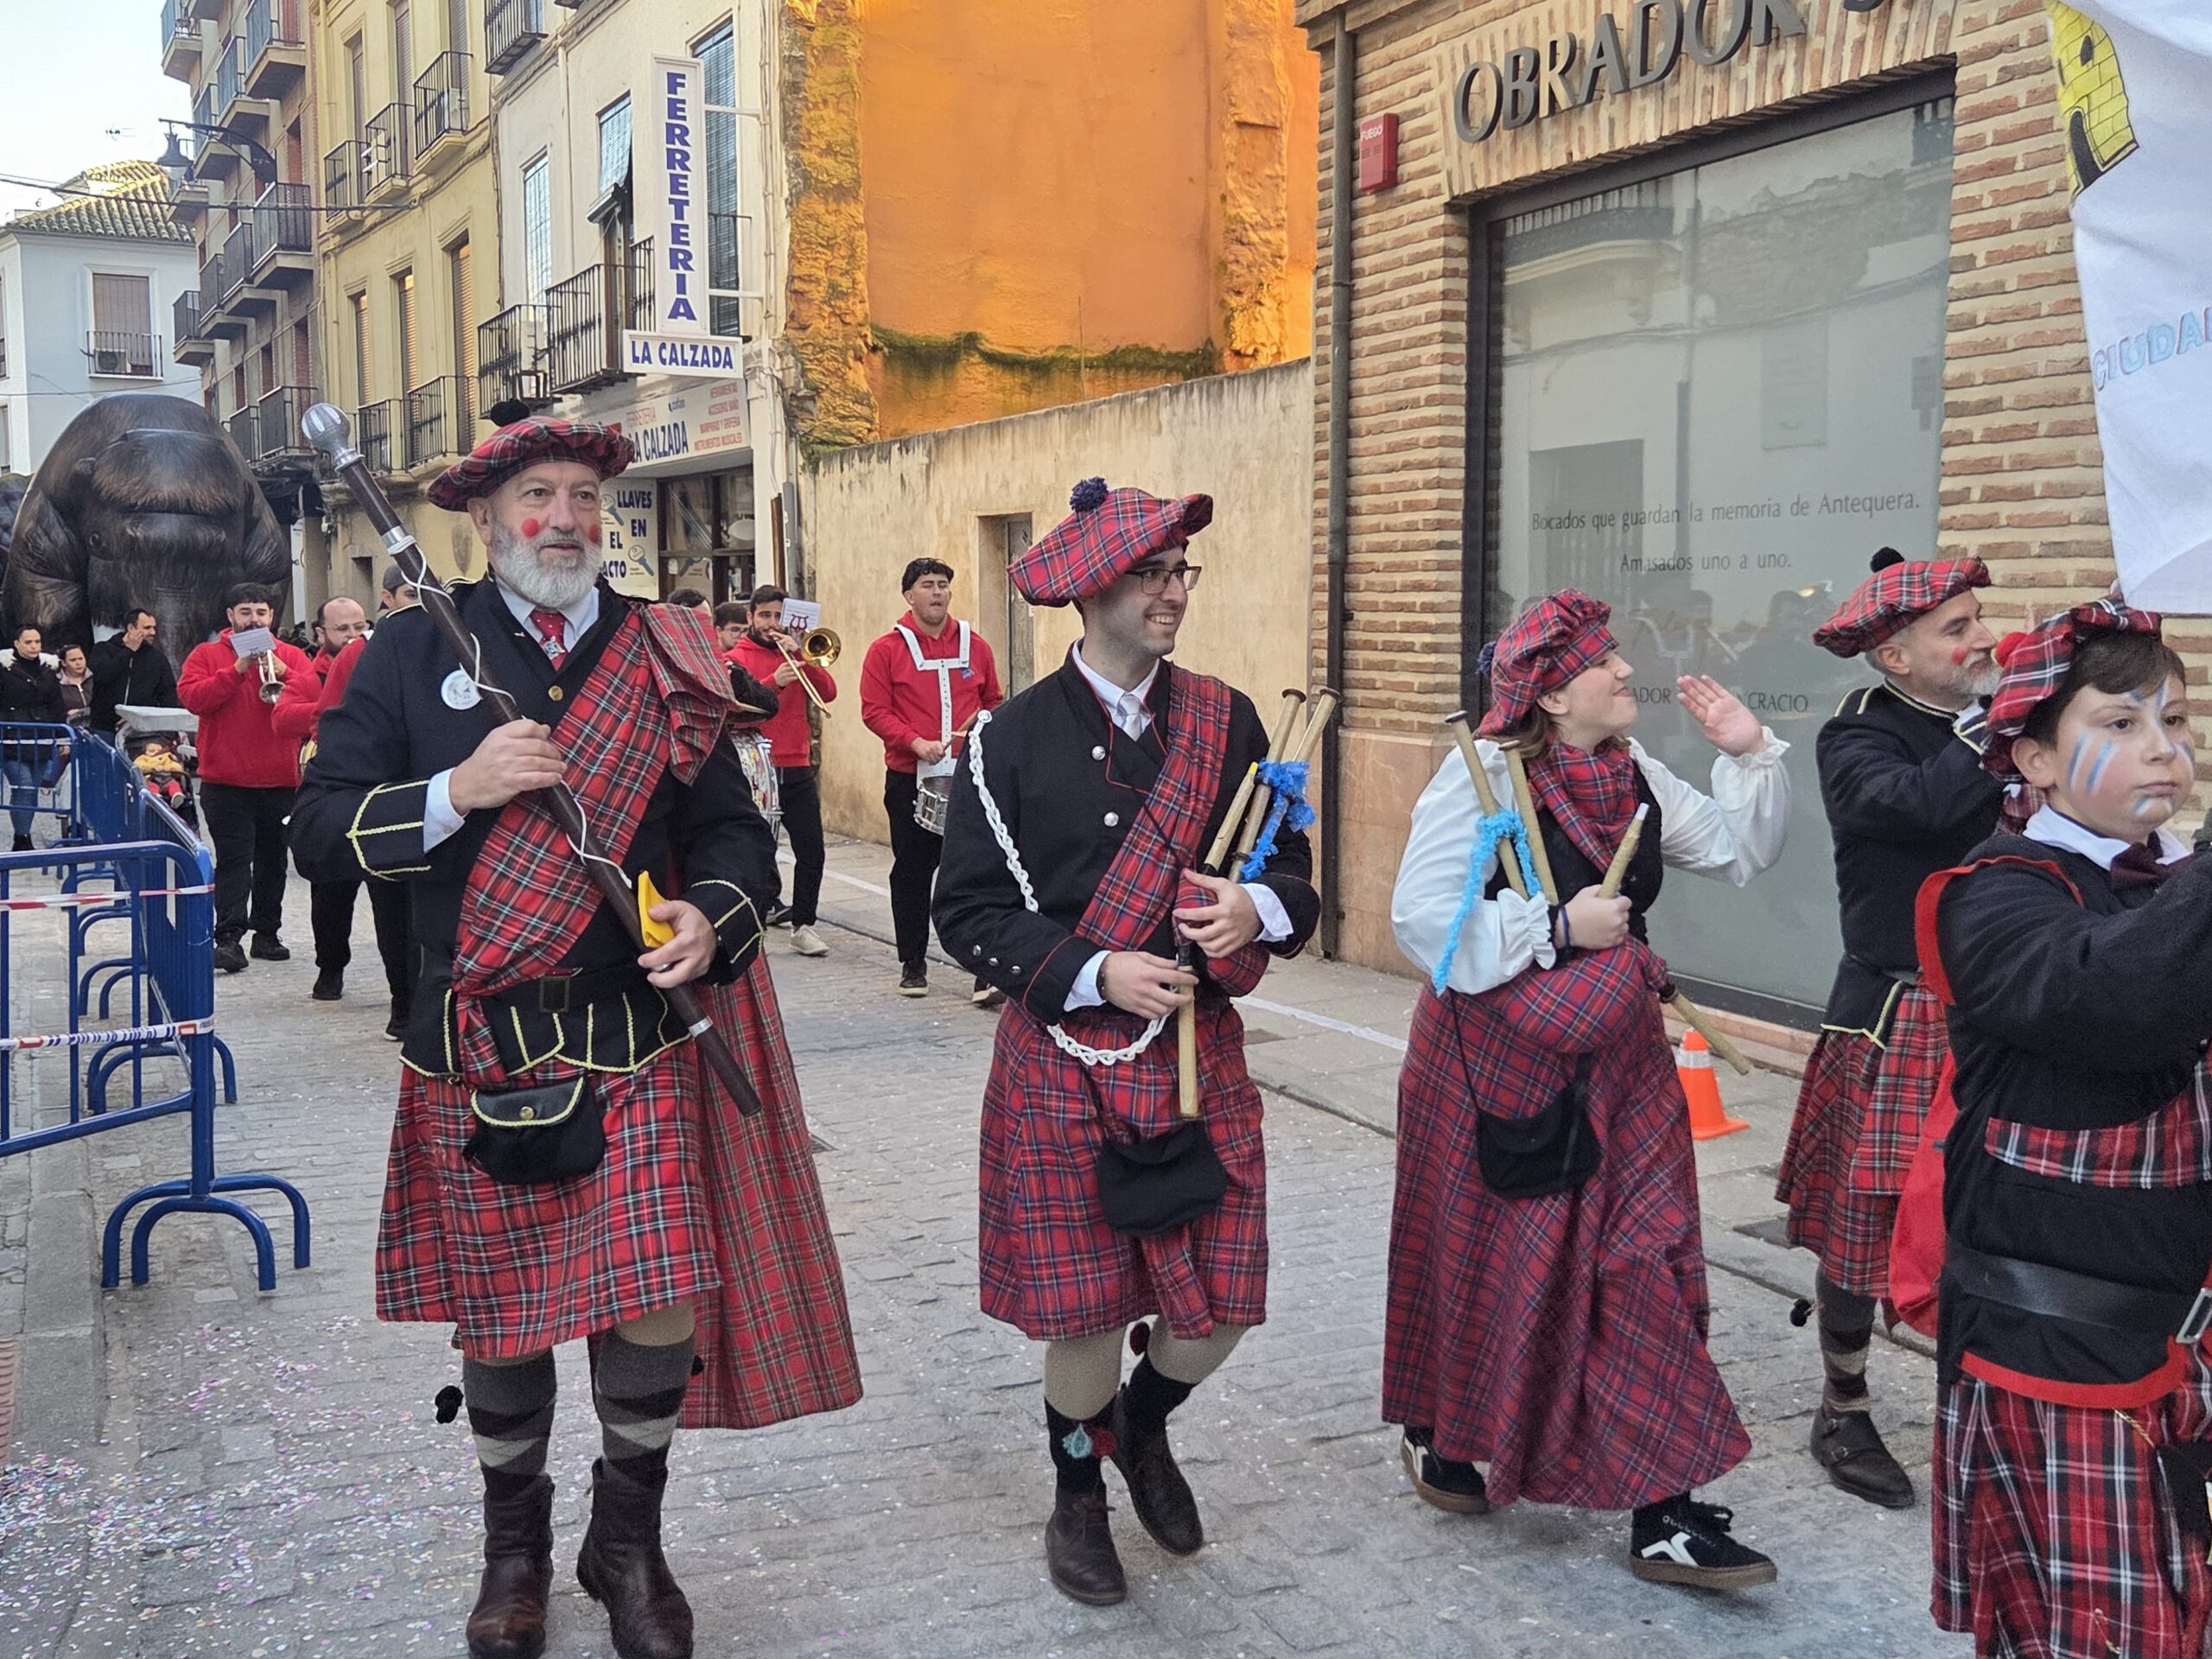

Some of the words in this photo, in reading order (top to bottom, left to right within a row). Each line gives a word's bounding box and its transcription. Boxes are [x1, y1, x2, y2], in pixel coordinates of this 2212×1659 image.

[1360, 125, 1383, 141] FUEGO
[664, 71, 697, 321] FERRETERIA
[631, 340, 652, 365] LA
[658, 341, 734, 370] CALZADA
[2092, 306, 2212, 392] CIUDA
[643, 420, 689, 461] CALZADA
[617, 490, 652, 509] LLAVES
[1532, 509, 1586, 531] Bocados
[1592, 512, 1616, 534] que
[1622, 504, 1680, 533] guardan
[1689, 501, 1703, 522] la
[1711, 498, 1781, 521] memoria
[1789, 493, 1810, 517] de
[1817, 493, 1920, 518] Antequera.
[631, 518, 646, 537] EN
[610, 531, 623, 550] EL
[601, 560, 626, 578] ACTO
[1620, 551, 1693, 572] Amasados
[1700, 555, 1731, 570] uno
[1738, 553, 1748, 570] a
[1758, 553, 1793, 569] uno.
